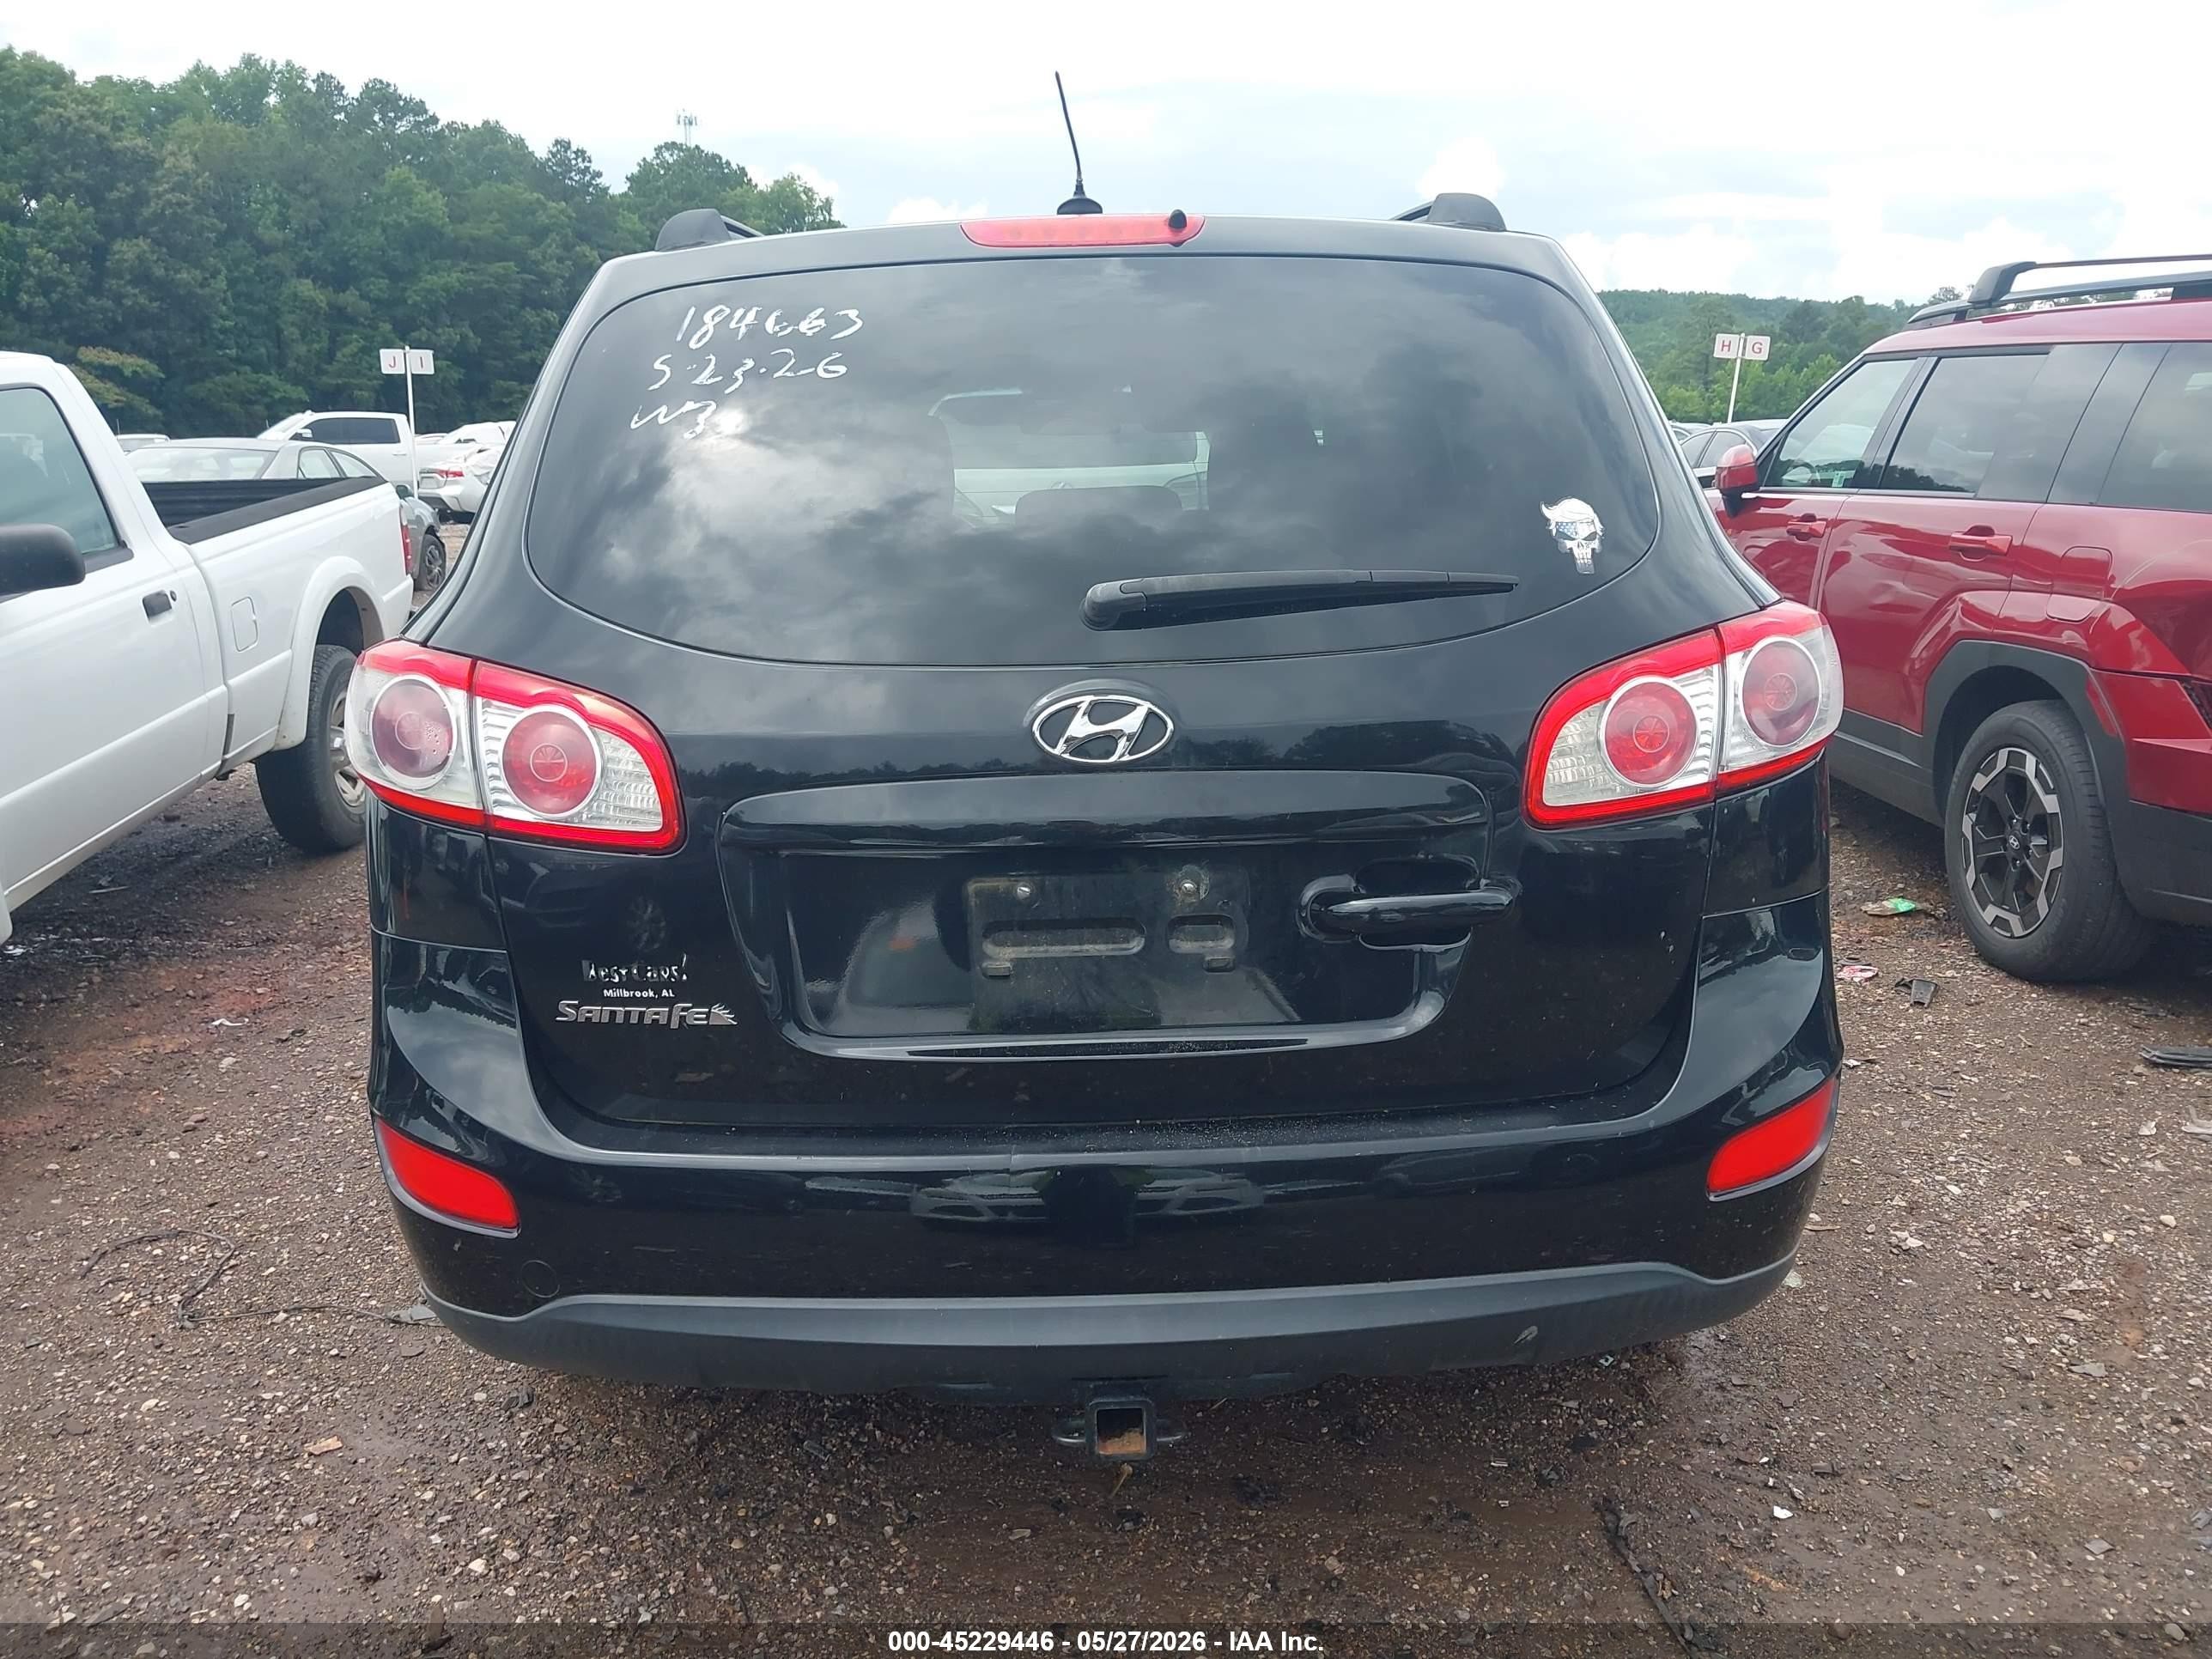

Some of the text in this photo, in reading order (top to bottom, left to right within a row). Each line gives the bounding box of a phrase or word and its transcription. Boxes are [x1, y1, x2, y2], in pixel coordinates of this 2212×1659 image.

[1721, 339, 1732, 352] H
[1752, 341, 1764, 355] G
[388, 356, 397, 368] J
[603, 988, 676, 1000] Millbrook, AL
